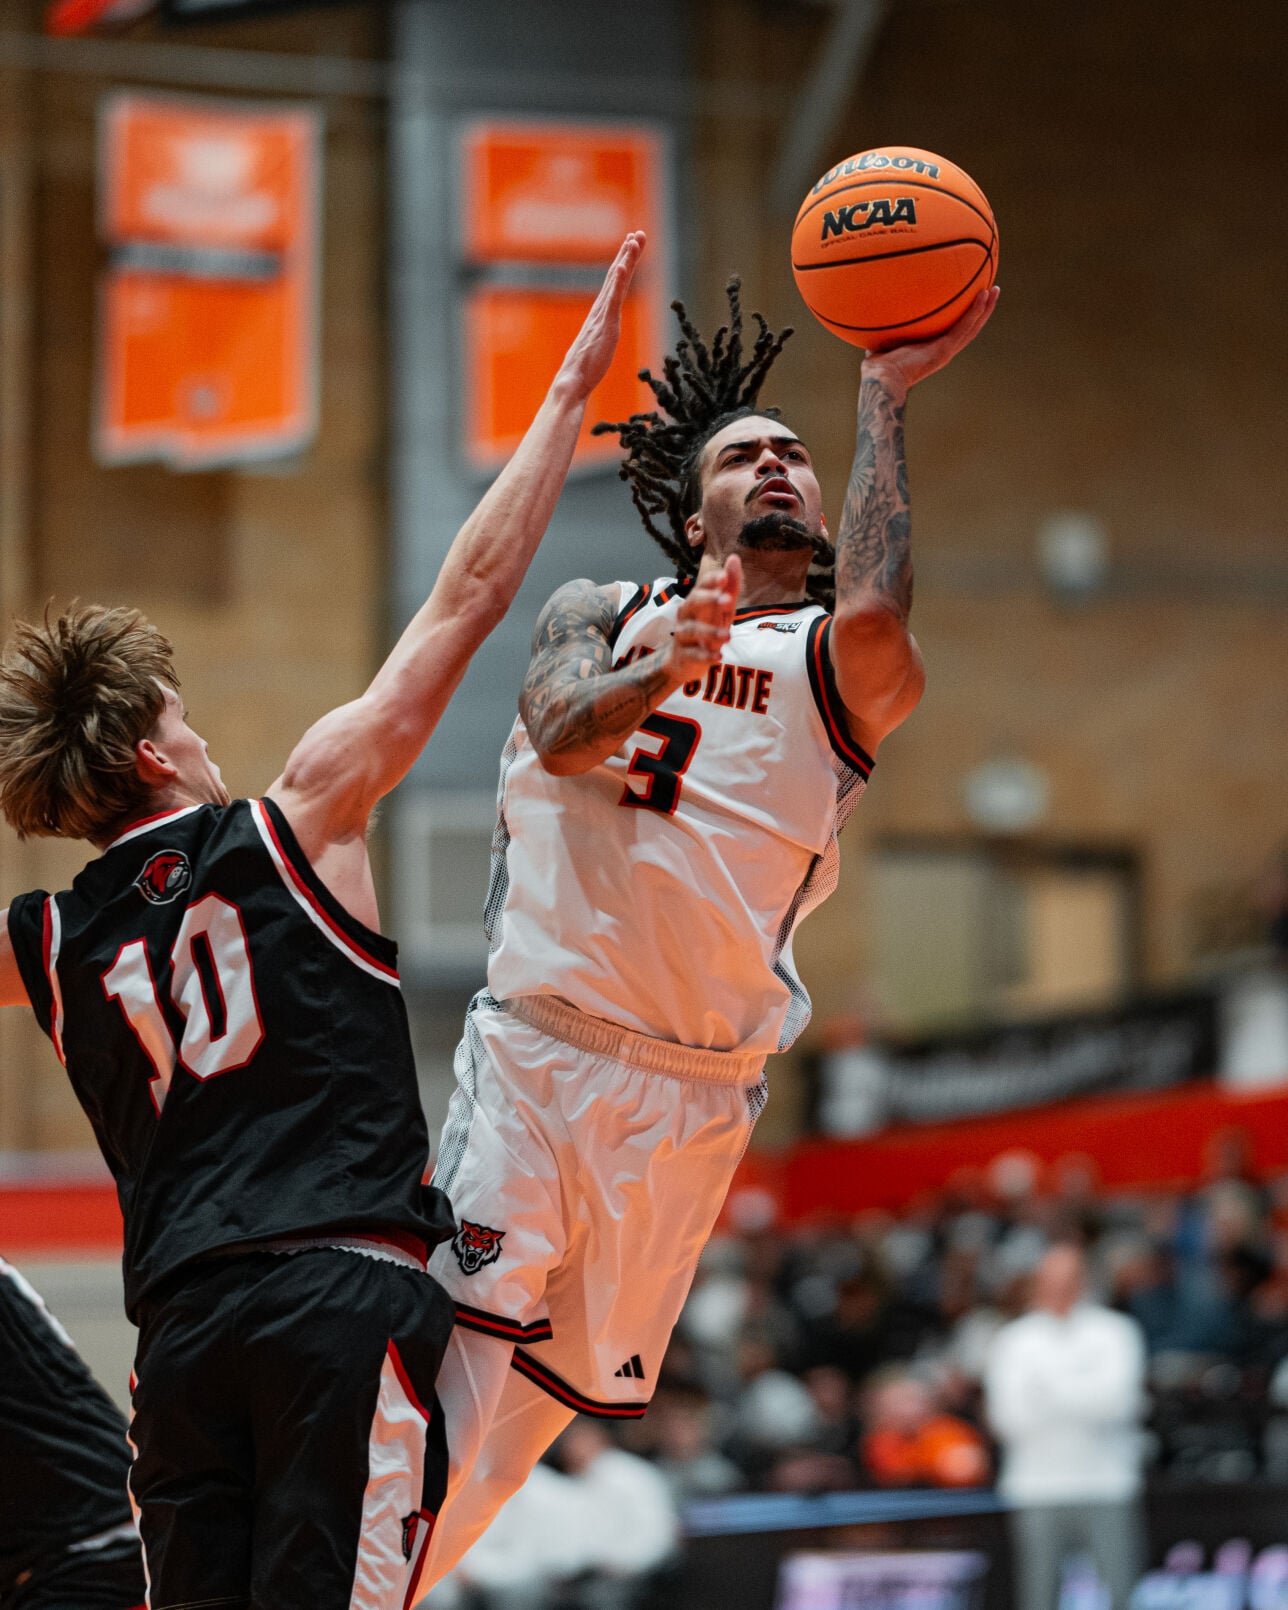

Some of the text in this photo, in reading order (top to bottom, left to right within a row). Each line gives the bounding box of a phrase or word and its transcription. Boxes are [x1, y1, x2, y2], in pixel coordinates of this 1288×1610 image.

[820, 197, 917, 241] NCAA
[618, 711, 703, 816] 3
[100, 890, 266, 1120] 10
